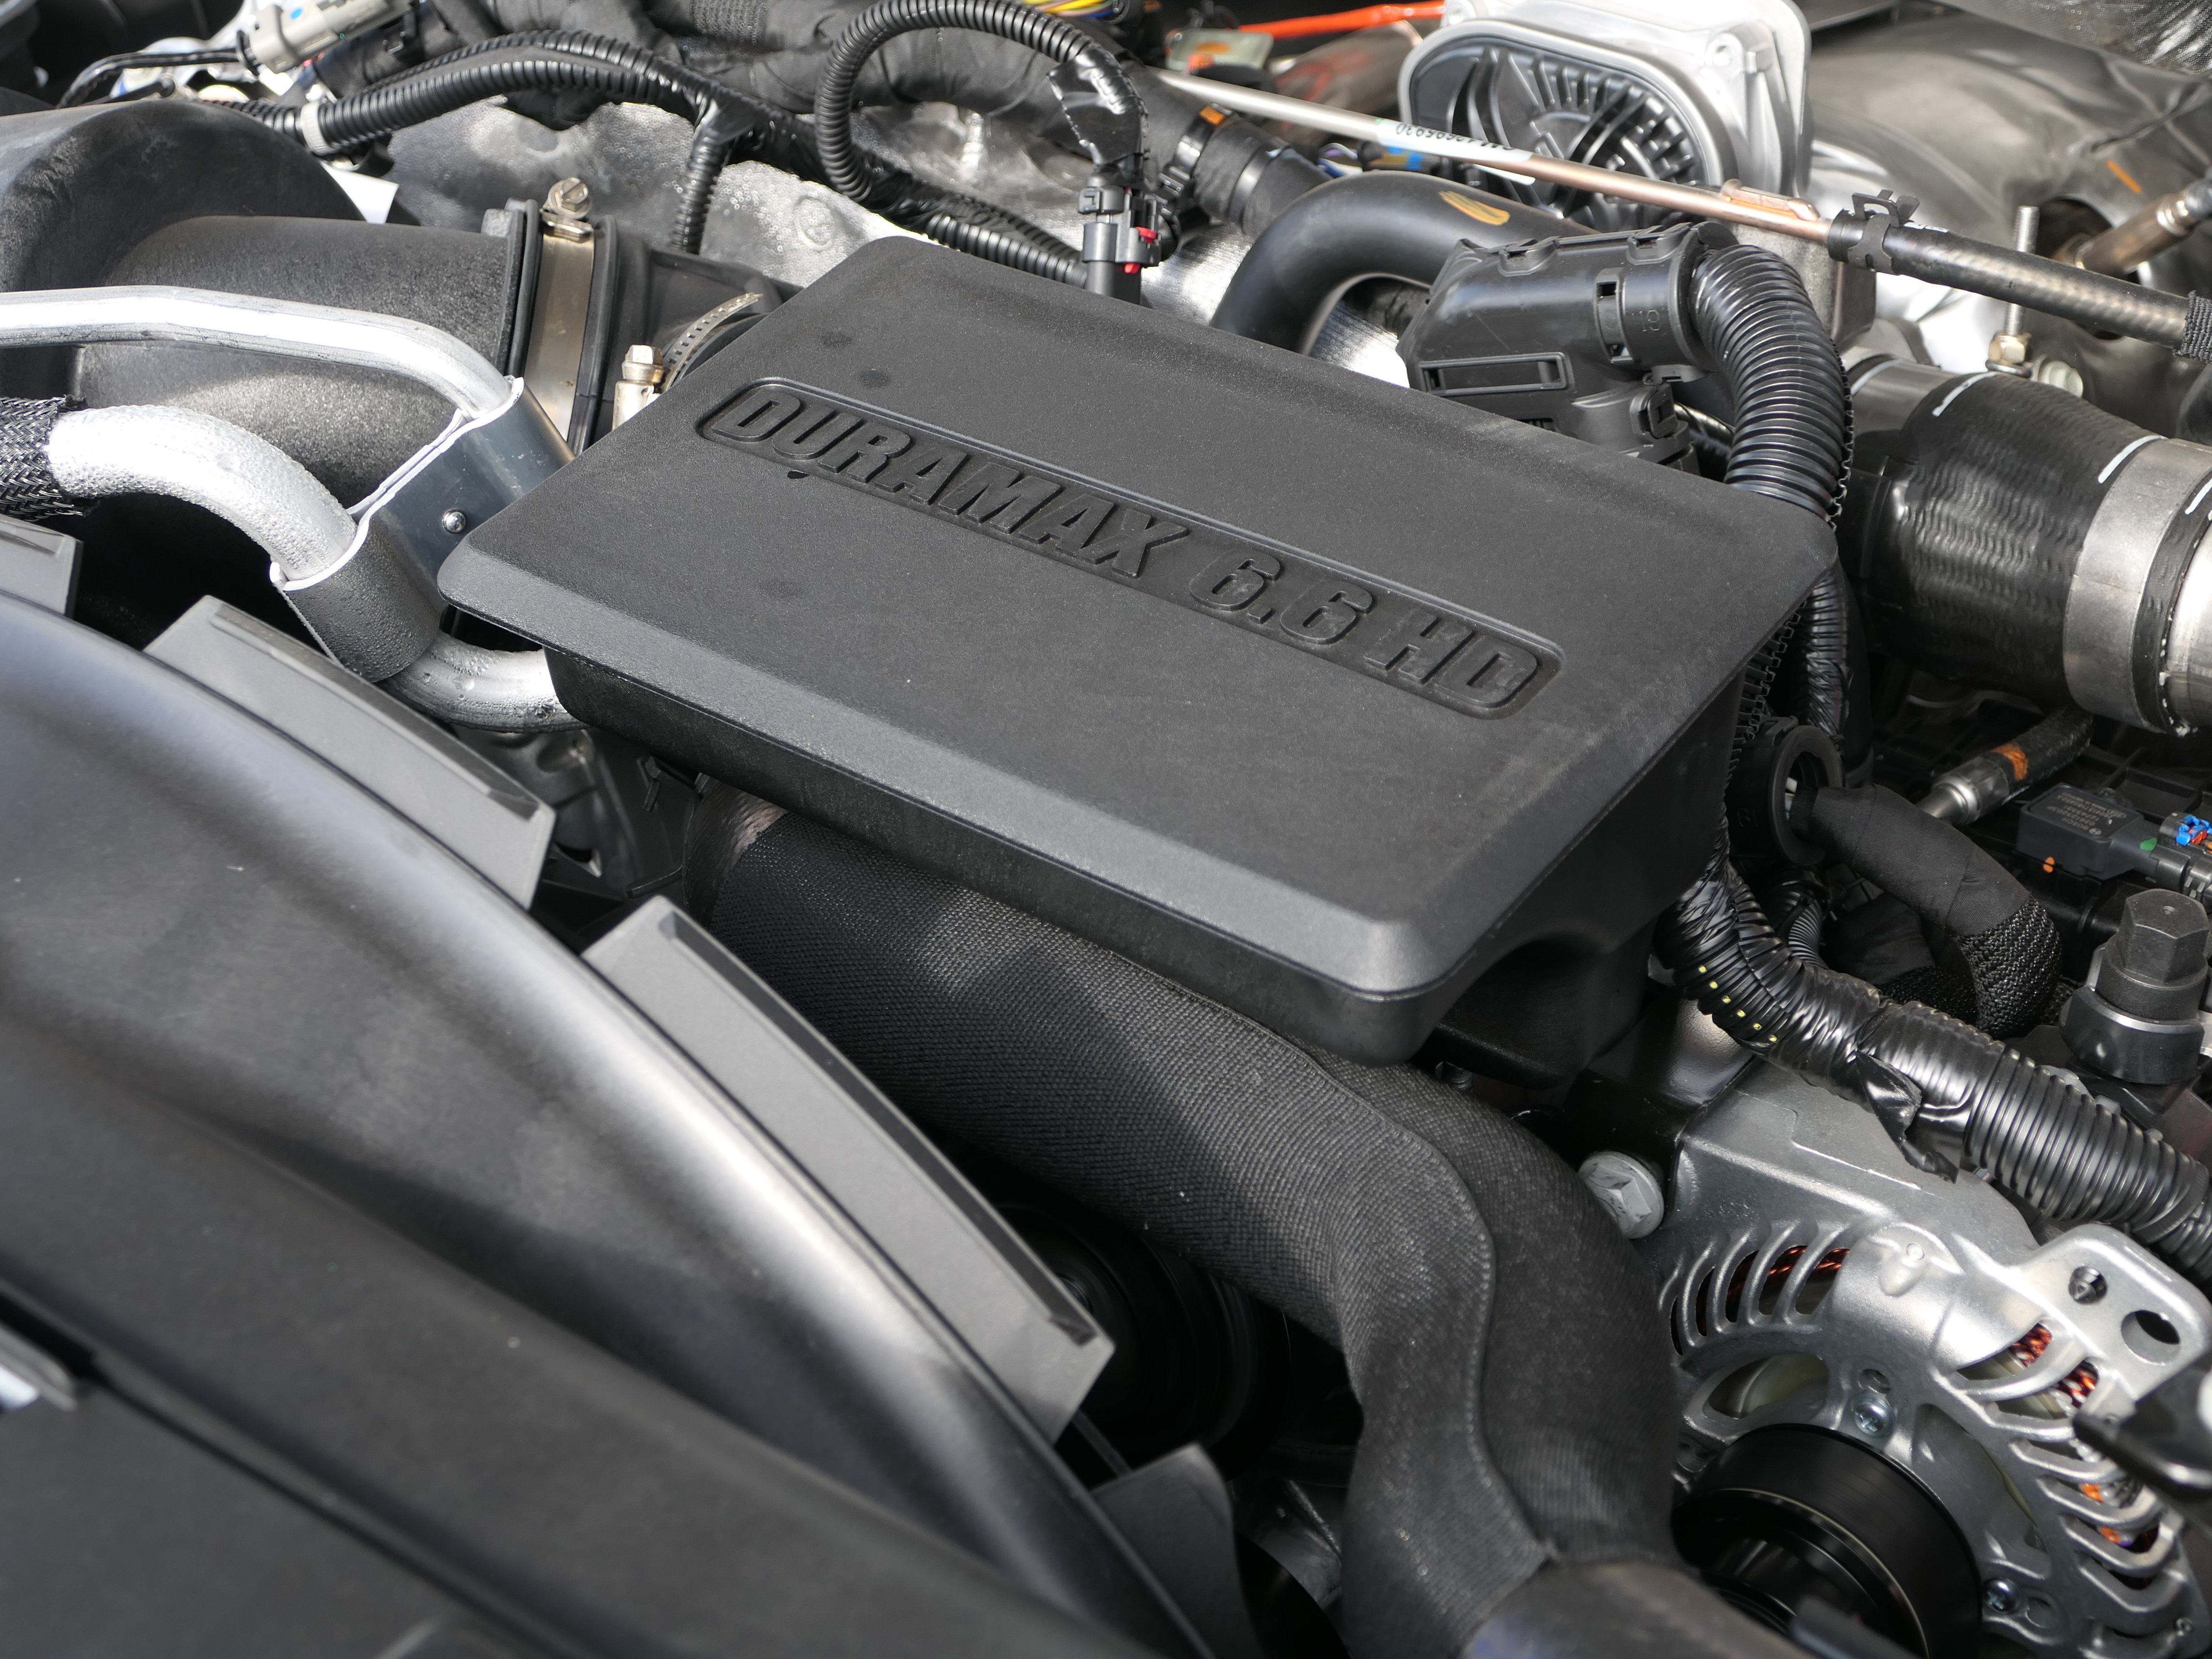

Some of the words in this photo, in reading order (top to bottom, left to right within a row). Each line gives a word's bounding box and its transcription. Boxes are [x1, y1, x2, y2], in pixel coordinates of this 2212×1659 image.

[712, 387, 1190, 579] DURAMAX
[1189, 548, 1375, 645] 6.6
[1364, 610, 1540, 709] HD
